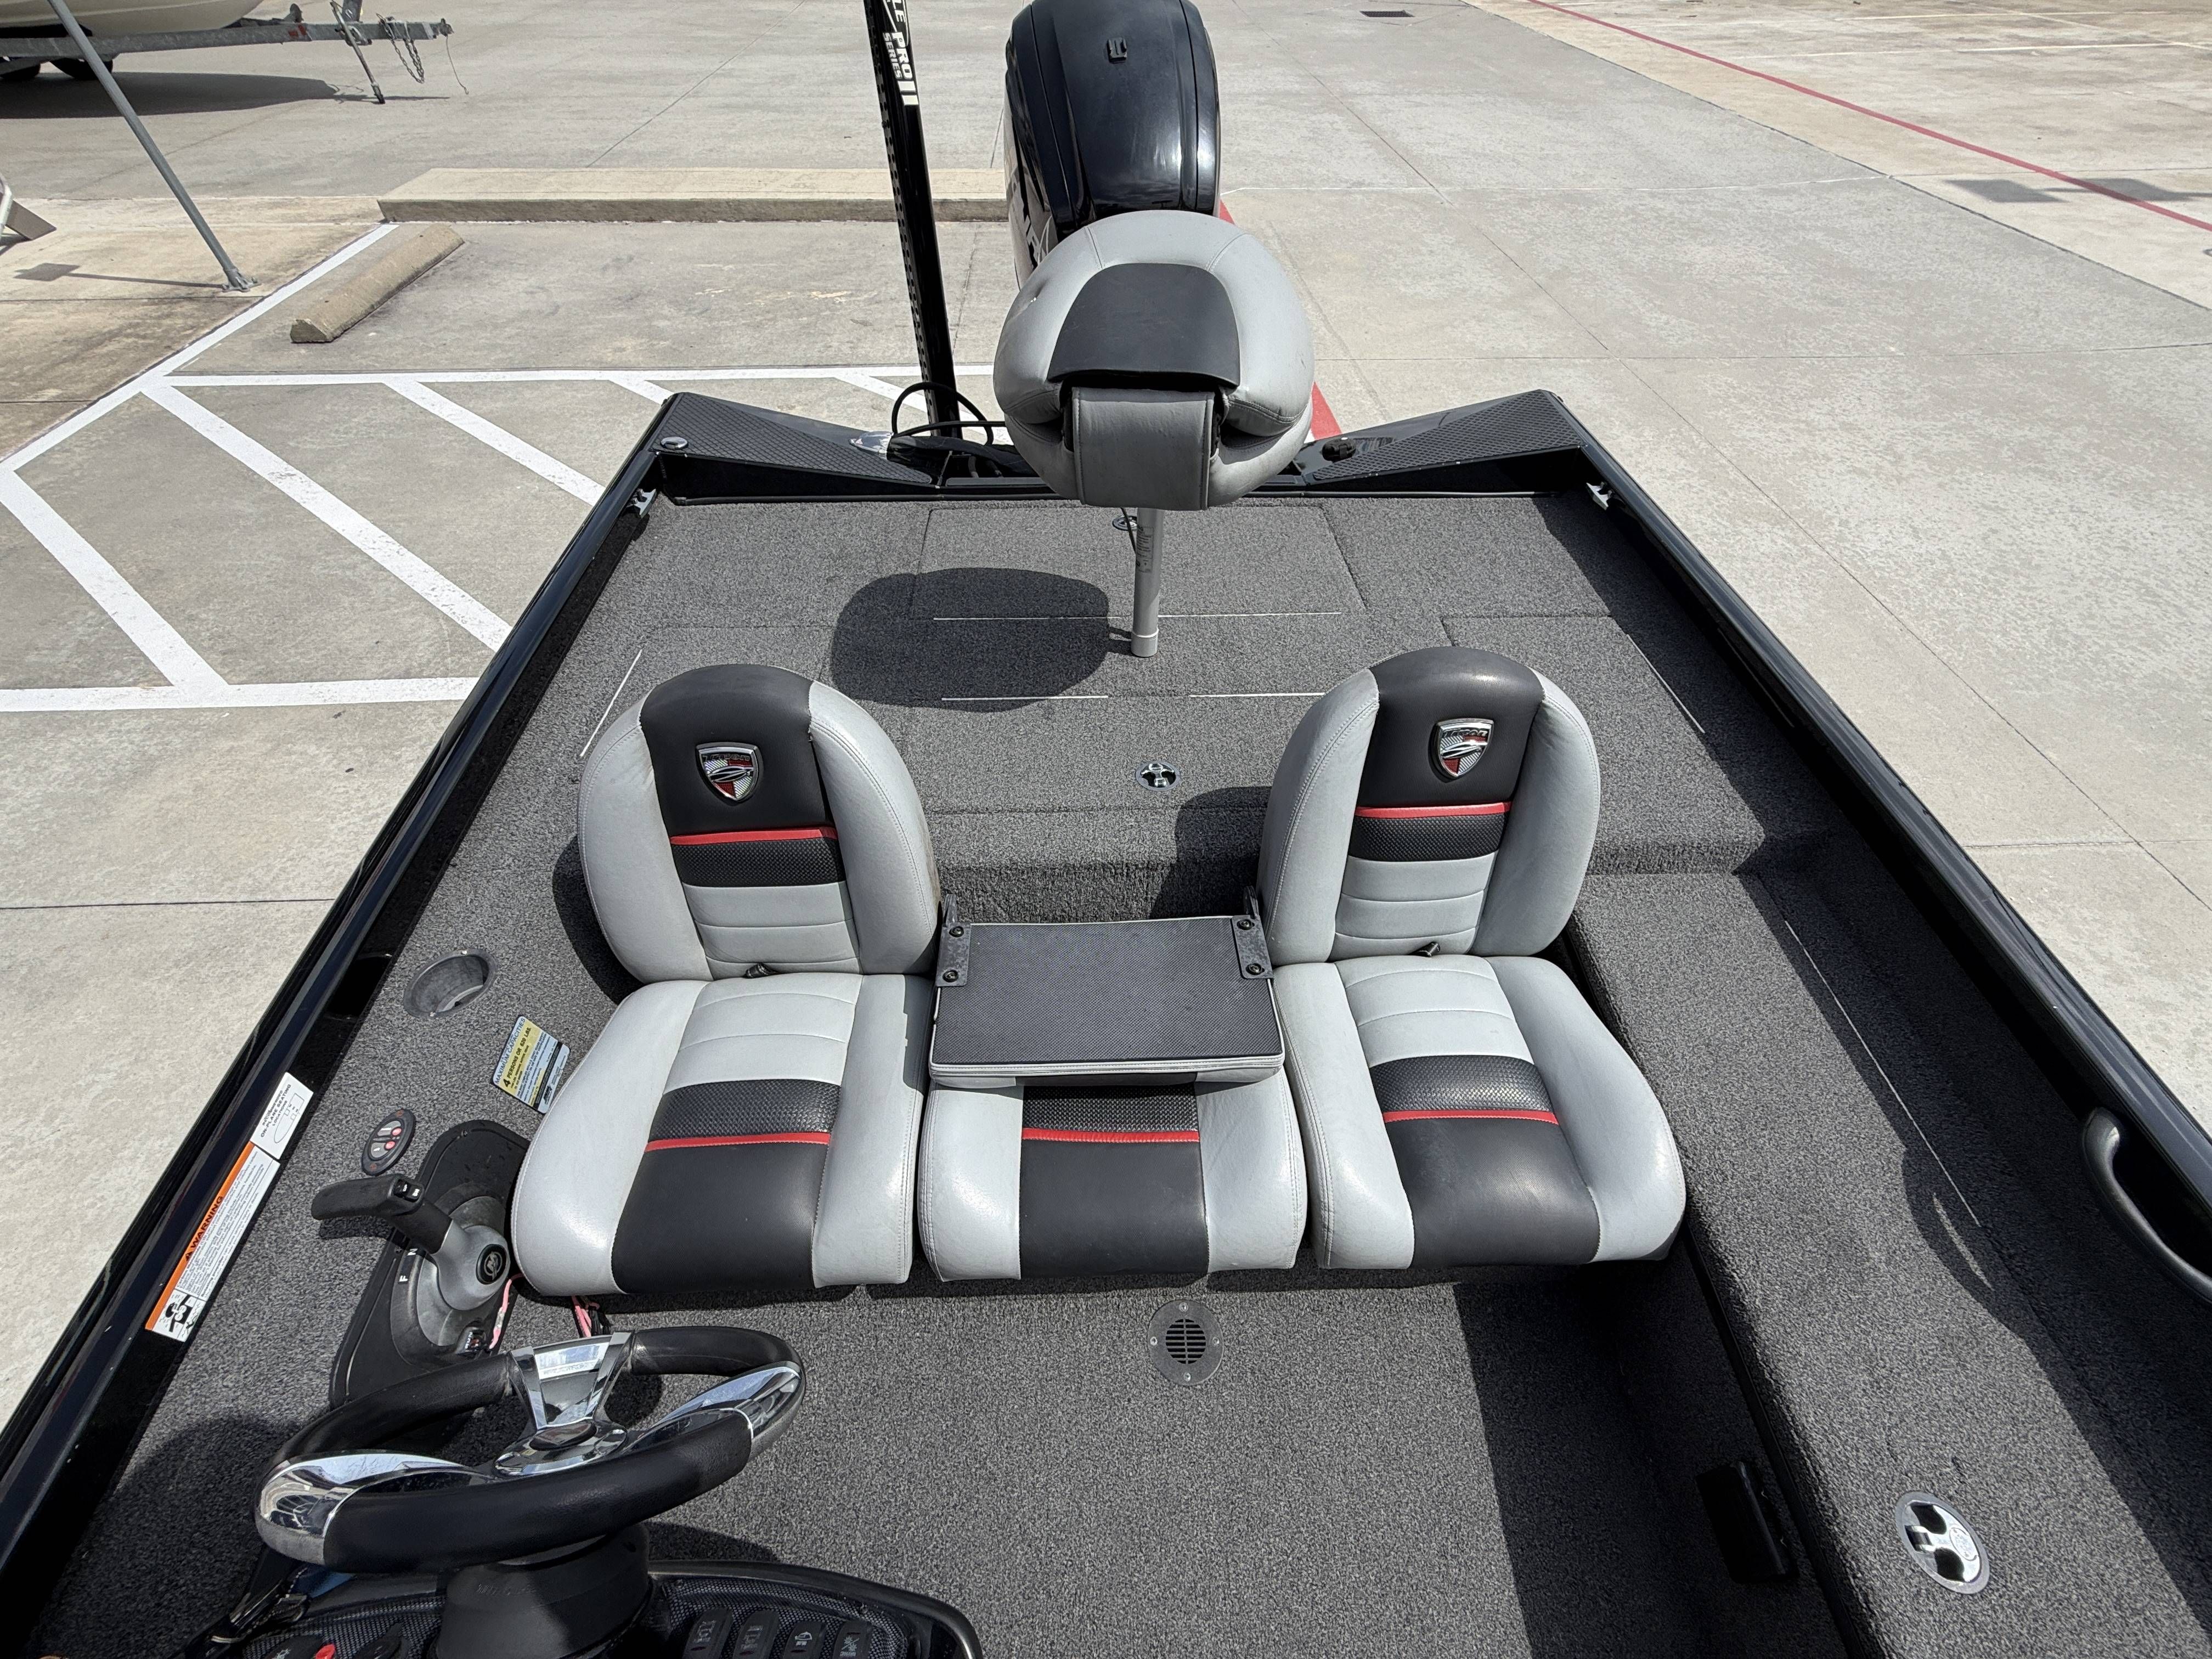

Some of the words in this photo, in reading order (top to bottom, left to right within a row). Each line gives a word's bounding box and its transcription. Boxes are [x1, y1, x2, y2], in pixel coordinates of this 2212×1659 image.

[883, 32, 902, 79] SERIES
[892, 32, 913, 79] PRO
[494, 1054, 509, 1084] MAXIMUM
[508, 1018, 525, 1053] CAPACITIES
[503, 1079, 511, 1087] 4
[507, 1056, 518, 1079] PERSONS
[516, 1047, 522, 1056] OR
[261, 1109, 277, 1137] ON-PLANE
[276, 1084, 291, 1108] SEATING
[272, 1100, 287, 1126] LOCATIONS
[190, 1197, 223, 1248] WARNING
[465, 1331, 473, 1349] RUN
